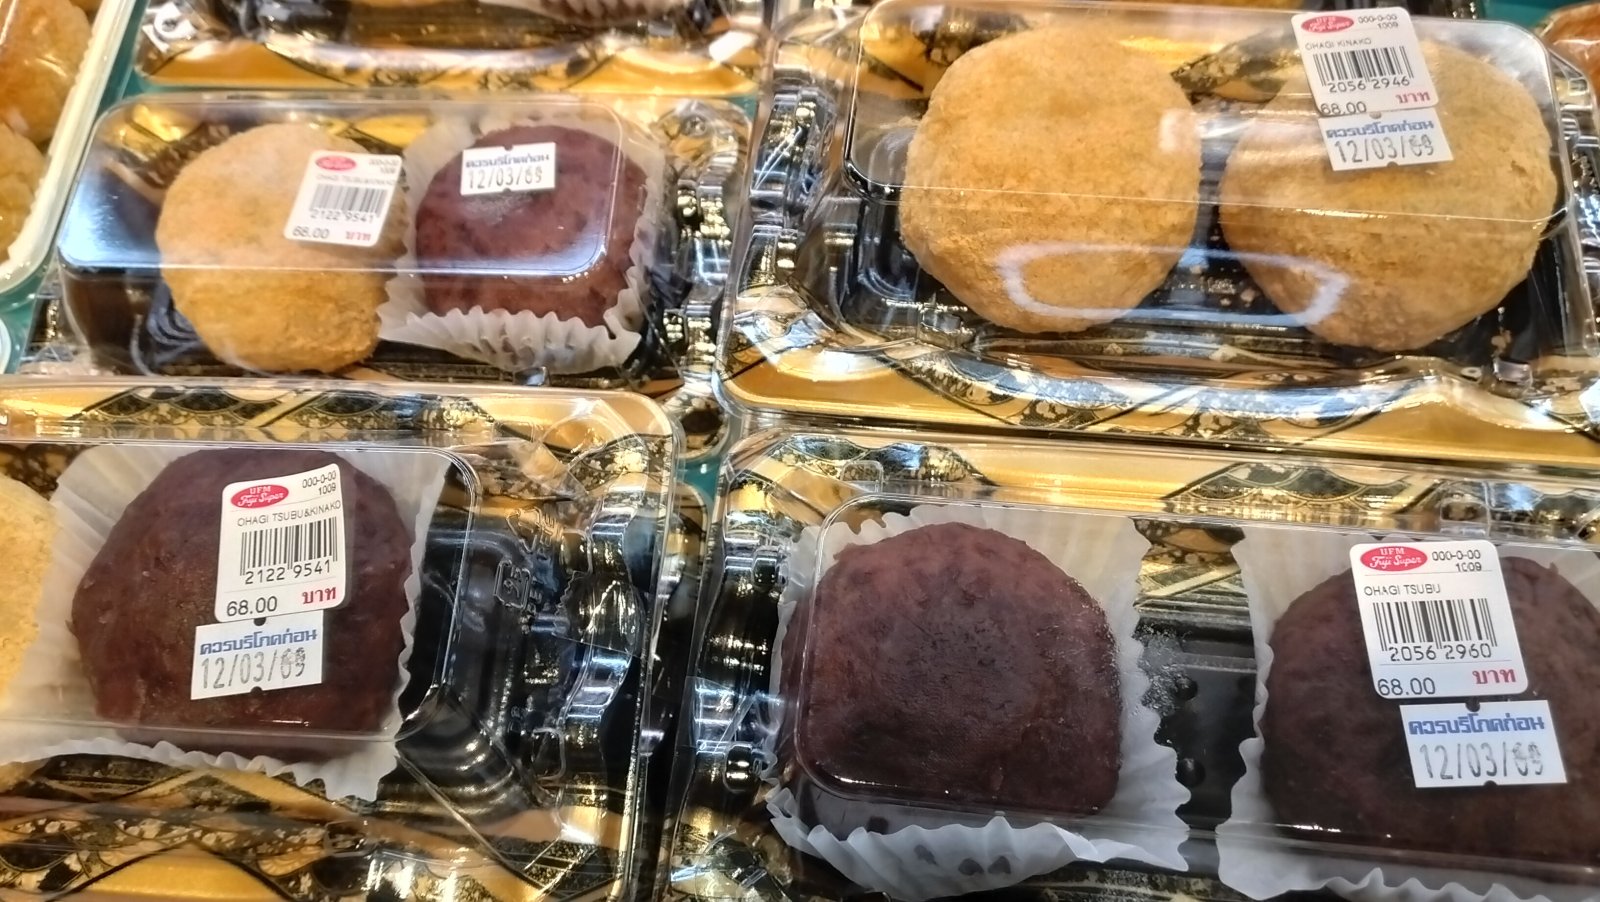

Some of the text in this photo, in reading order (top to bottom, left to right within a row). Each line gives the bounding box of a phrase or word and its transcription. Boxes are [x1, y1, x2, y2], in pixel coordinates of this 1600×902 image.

[1305, 38, 1372, 51] OHAGI KINAKO
[1328, 76, 1411, 93] 2056 2946
[1395, 90, 1431, 104] บาท
[1320, 101, 1367, 115] 68.00
[292, 225, 331, 239] 68.00
[302, 470, 337, 488] 000-0-00
[249, 485, 271, 495] UFM
[318, 484, 337, 496] 1009
[237, 499, 341, 527] OHAGI TSUBU&KINAKO
[1379, 546, 1405, 556] UFM
[1432, 549, 1481, 561] 000-0-00
[1369, 555, 1422, 569] Fuji Super
[245, 559, 331, 585] 2122 9541
[301, 585, 337, 605] บาท
[1364, 584, 1441, 596] OHAGI TSUBU
[226, 595, 278, 617] 68.00
[200, 628, 318, 655] ควรบริโภคก่อน
[1388, 643, 1493, 661] 2056 2960
[1472, 667, 1516, 685] บาท
[1377, 677, 1436, 696] 68.00
[1408, 711, 1545, 736] ควรบริโภคก่อน
